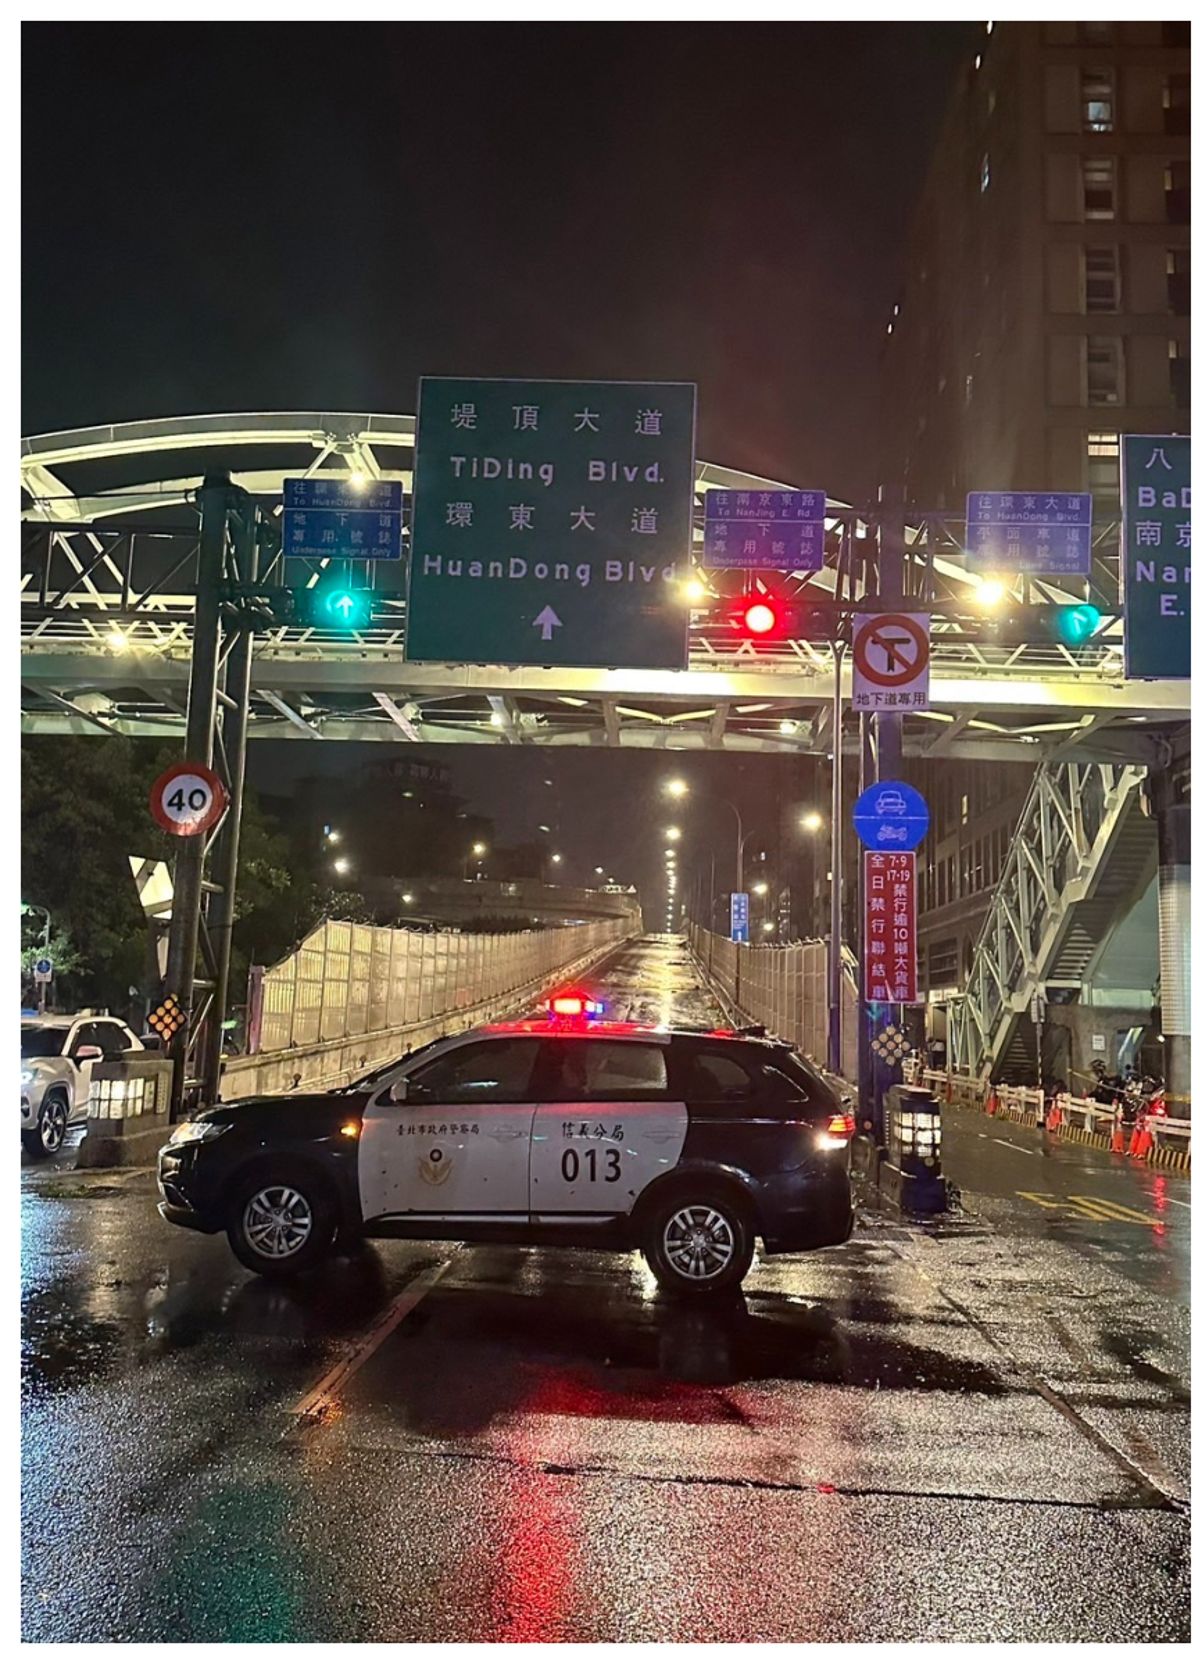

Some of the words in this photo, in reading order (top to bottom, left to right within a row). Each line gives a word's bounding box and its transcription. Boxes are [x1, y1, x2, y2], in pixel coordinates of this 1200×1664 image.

[450, 403, 663, 436] 堤頂大道
[1145, 448, 1172, 470] 八
[450, 456, 555, 485] TiDing
[588, 460, 665, 483] Blvd.
[716, 493, 815, 506] 往南京東路
[979, 495, 1080, 510] 往環東大道
[446, 502, 659, 535] 環東大道
[718, 508, 730, 516] To
[978, 512, 990, 520] To
[997, 512, 1048, 522] HuanDong
[715, 522, 814, 538] 地下道
[977, 526, 1080, 541] 平面車道
[423, 554, 592, 587] HuanDong
[1160, 594, 1185, 616] E.
[856, 692, 926, 705] 地下道專用
[167, 788, 207, 812] 40
[561, 1148, 622, 1182] 013
